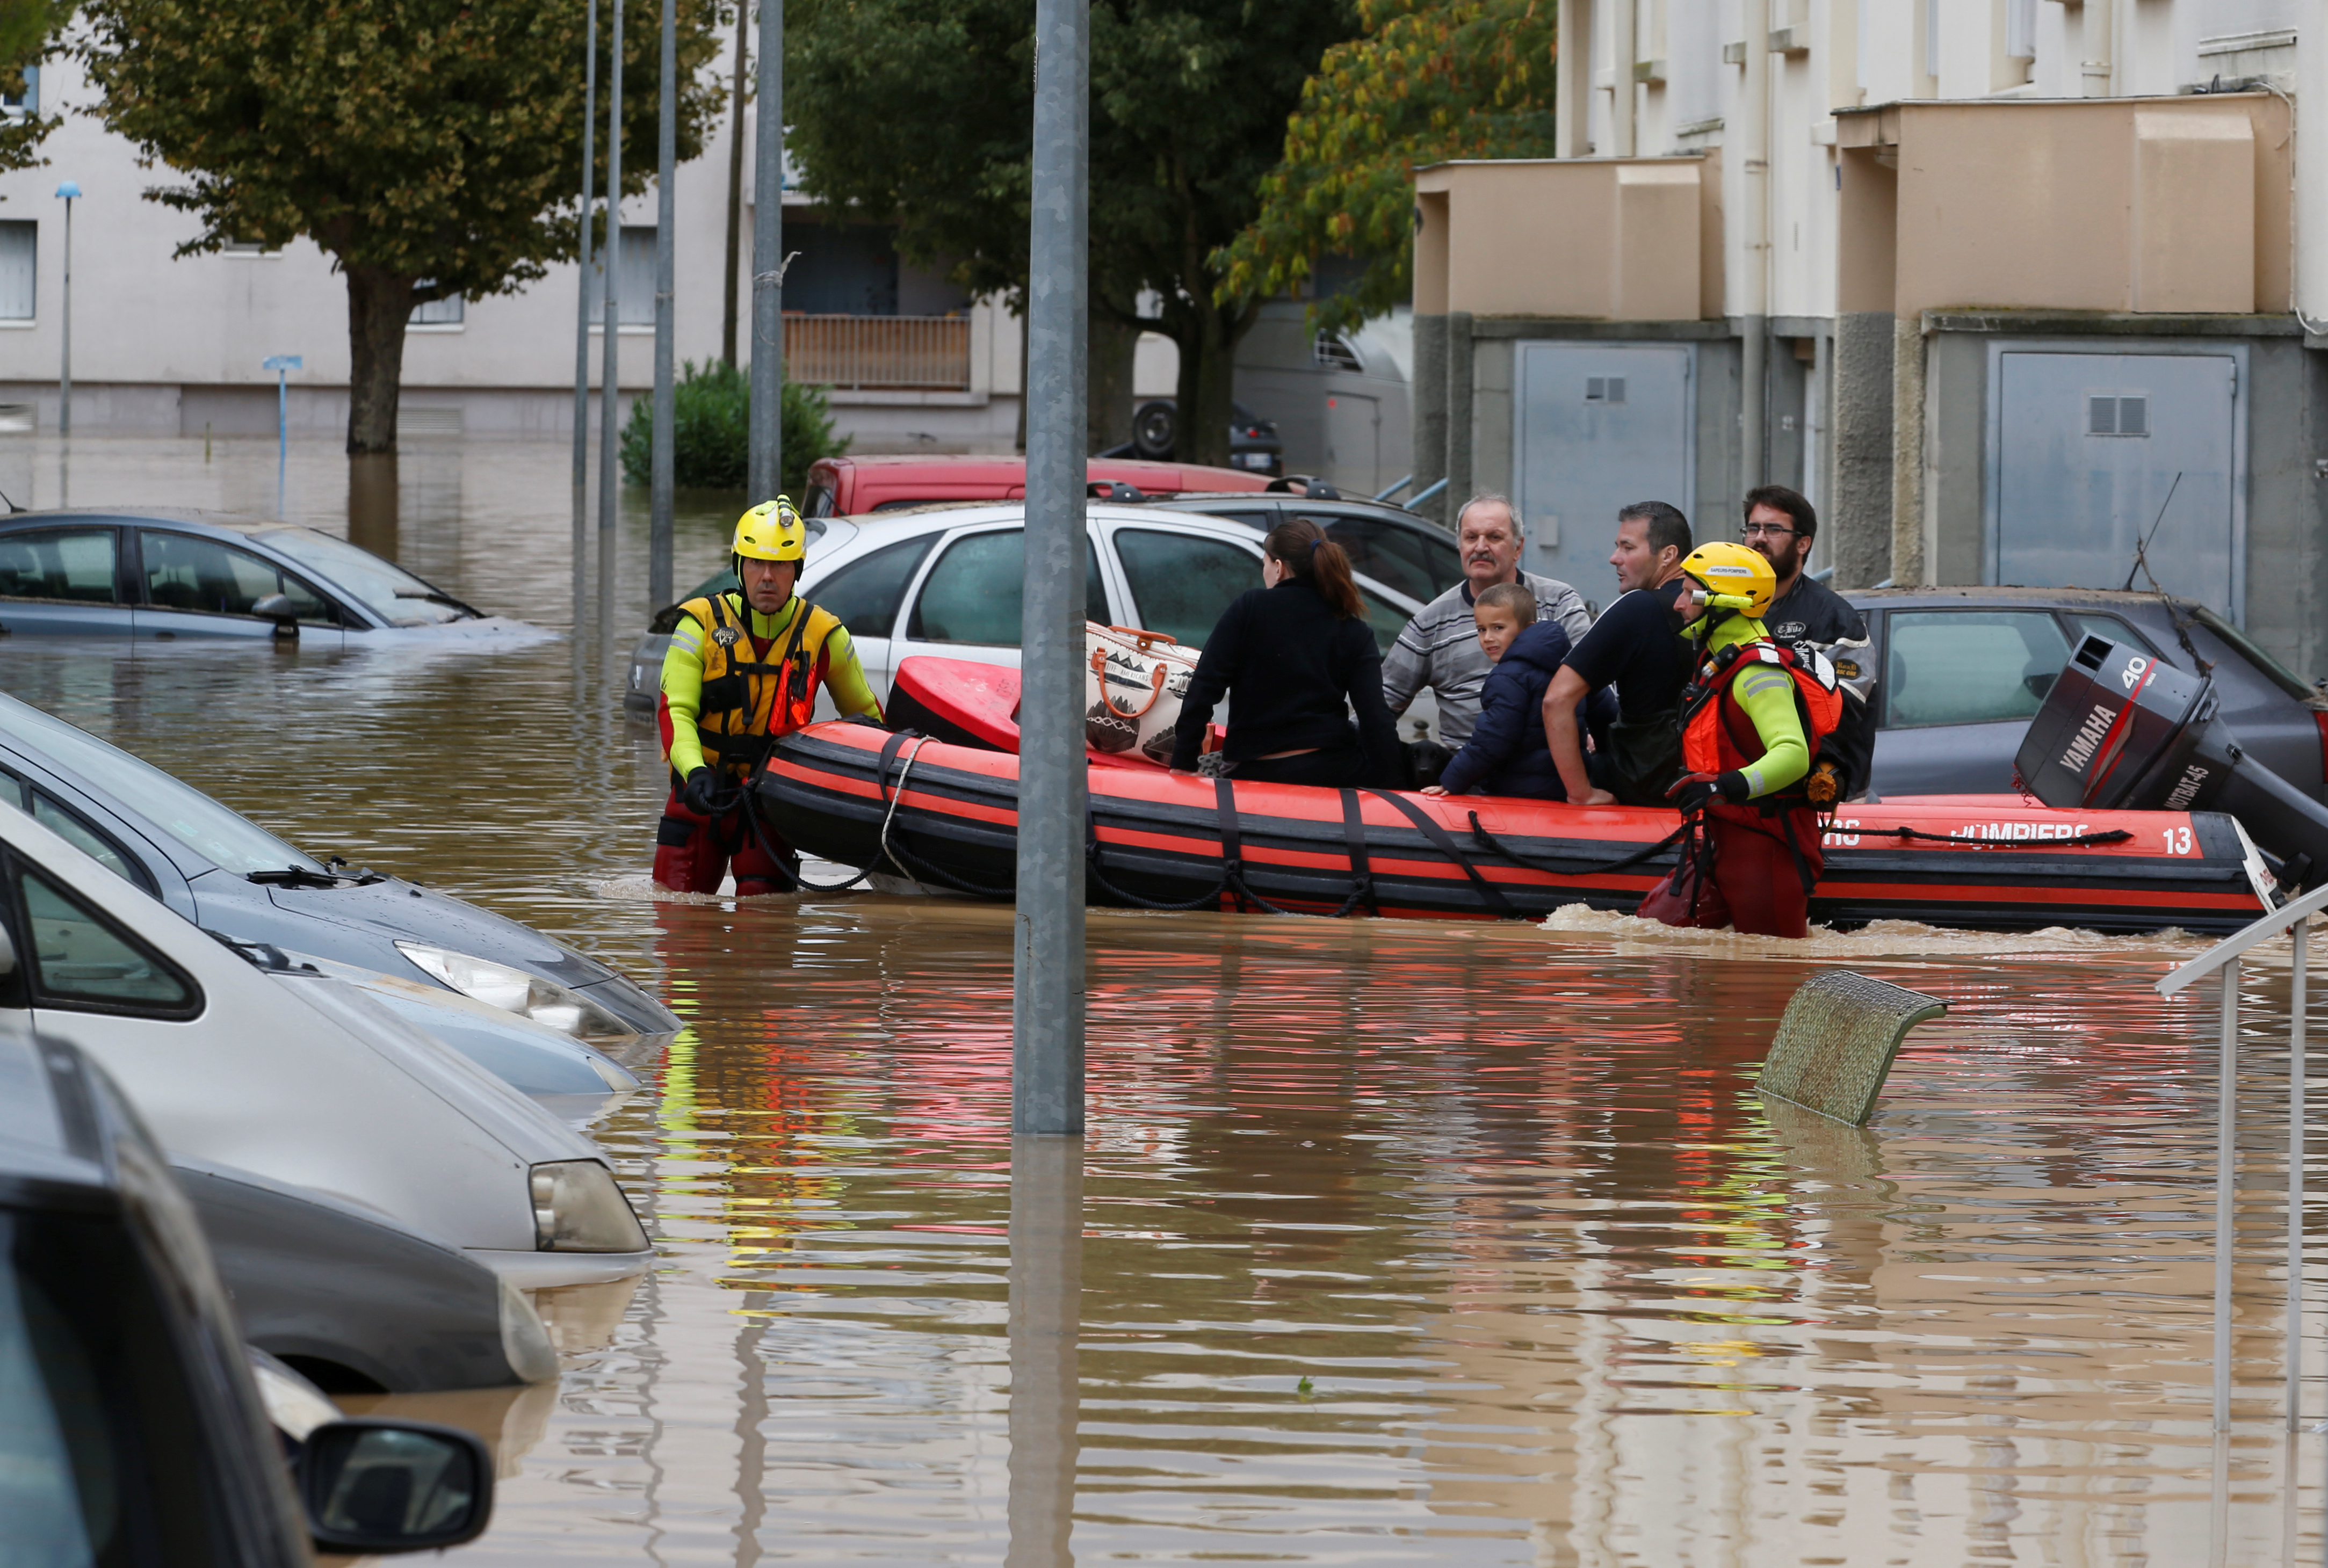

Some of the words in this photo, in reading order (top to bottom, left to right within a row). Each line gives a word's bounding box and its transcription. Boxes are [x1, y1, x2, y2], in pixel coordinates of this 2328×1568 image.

[1120, 669, 1149, 681] AMERICANS
[2122, 657, 2147, 689] 40
[2059, 704, 2117, 773] YAMAHA
[2164, 765, 2209, 811] MOTBAT-45
[2163, 826, 2192, 855] 13
